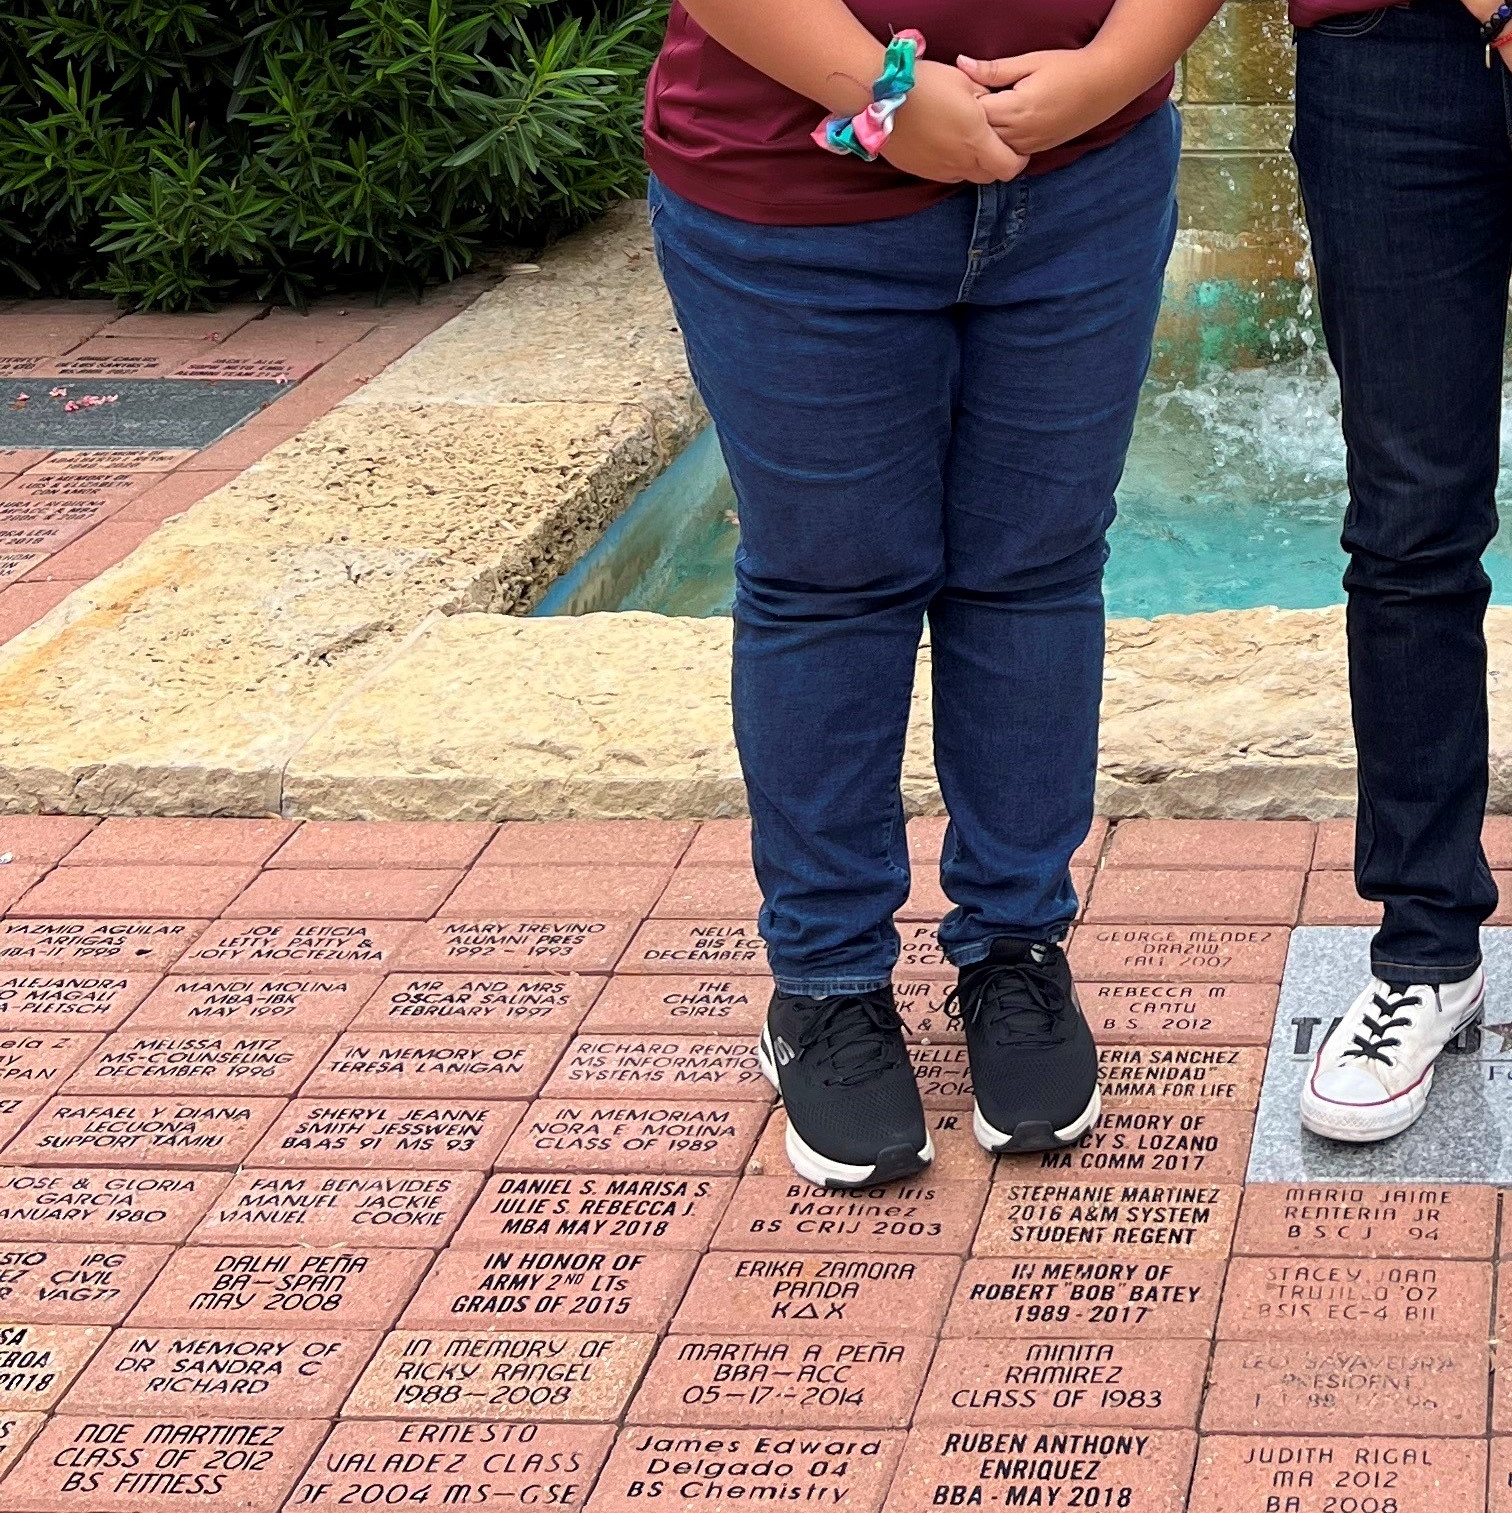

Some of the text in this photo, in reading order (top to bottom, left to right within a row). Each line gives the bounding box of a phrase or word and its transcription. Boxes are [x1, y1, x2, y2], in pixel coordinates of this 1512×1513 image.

[6, 925, 185, 934] YAZMID AGUILAR
[444, 924, 605, 933] MARY TREVINO
[36, 936, 127, 945] ARTIGAS
[446, 935, 585, 945] ALUMNI PRES
[407, 982, 566, 993] MR AND MRS
[392, 993, 570, 1005] OSCAR SALINAS
[389, 1006, 553, 1017] FEBRUARY 1997
[345, 1048, 525, 1060] IN MEMORY OF
[331, 1062, 524, 1073] TERESA LANIGAN
[556, 1109, 729, 1122] IN MEMORIAM
[530, 1123, 735, 1136] NORA E MOLINA
[535, 1138, 718, 1151] CLASS OF 1989
[498, 1179, 571, 1194] DANIEL
[606, 1181, 687, 1196] MARISA
[1008, 1186, 1220, 1204] STEPHANIE MARTINEZ
[1008, 1205, 1209, 1224] 2016 A&M SYSTEM
[501, 1219, 669, 1236] MBA MAY 2018
[1010, 1226, 1197, 1245] STUDENT REGENT
[214, 1254, 369, 1273] DALHI PEÑA
[484, 1253, 646, 1271] IN HONOR OF
[189, 1293, 343, 1311] MAY 2008
[451, 1295, 632, 1314] GRADS OF 2015
[1026, 1344, 1113, 1361] MINITA
[1005, 1366, 1122, 1383] RAMIREZ
[952, 1390, 1161, 1408] CLASS OF 1983
[74, 1424, 284, 1446] NOE MARTINEZ
[636, 1436, 881, 1455] James Edward
[941, 1434, 1149, 1456] RUBEN ANTHONY
[54, 1448, 273, 1470] CLASS OF 2012
[647, 1459, 848, 1479] Delgado 04
[980, 1460, 1101, 1481] ENRIQUEZ
[61, 1472, 227, 1494] BS FITNESS
[627, 1481, 849, 1504] BS Chemistry
